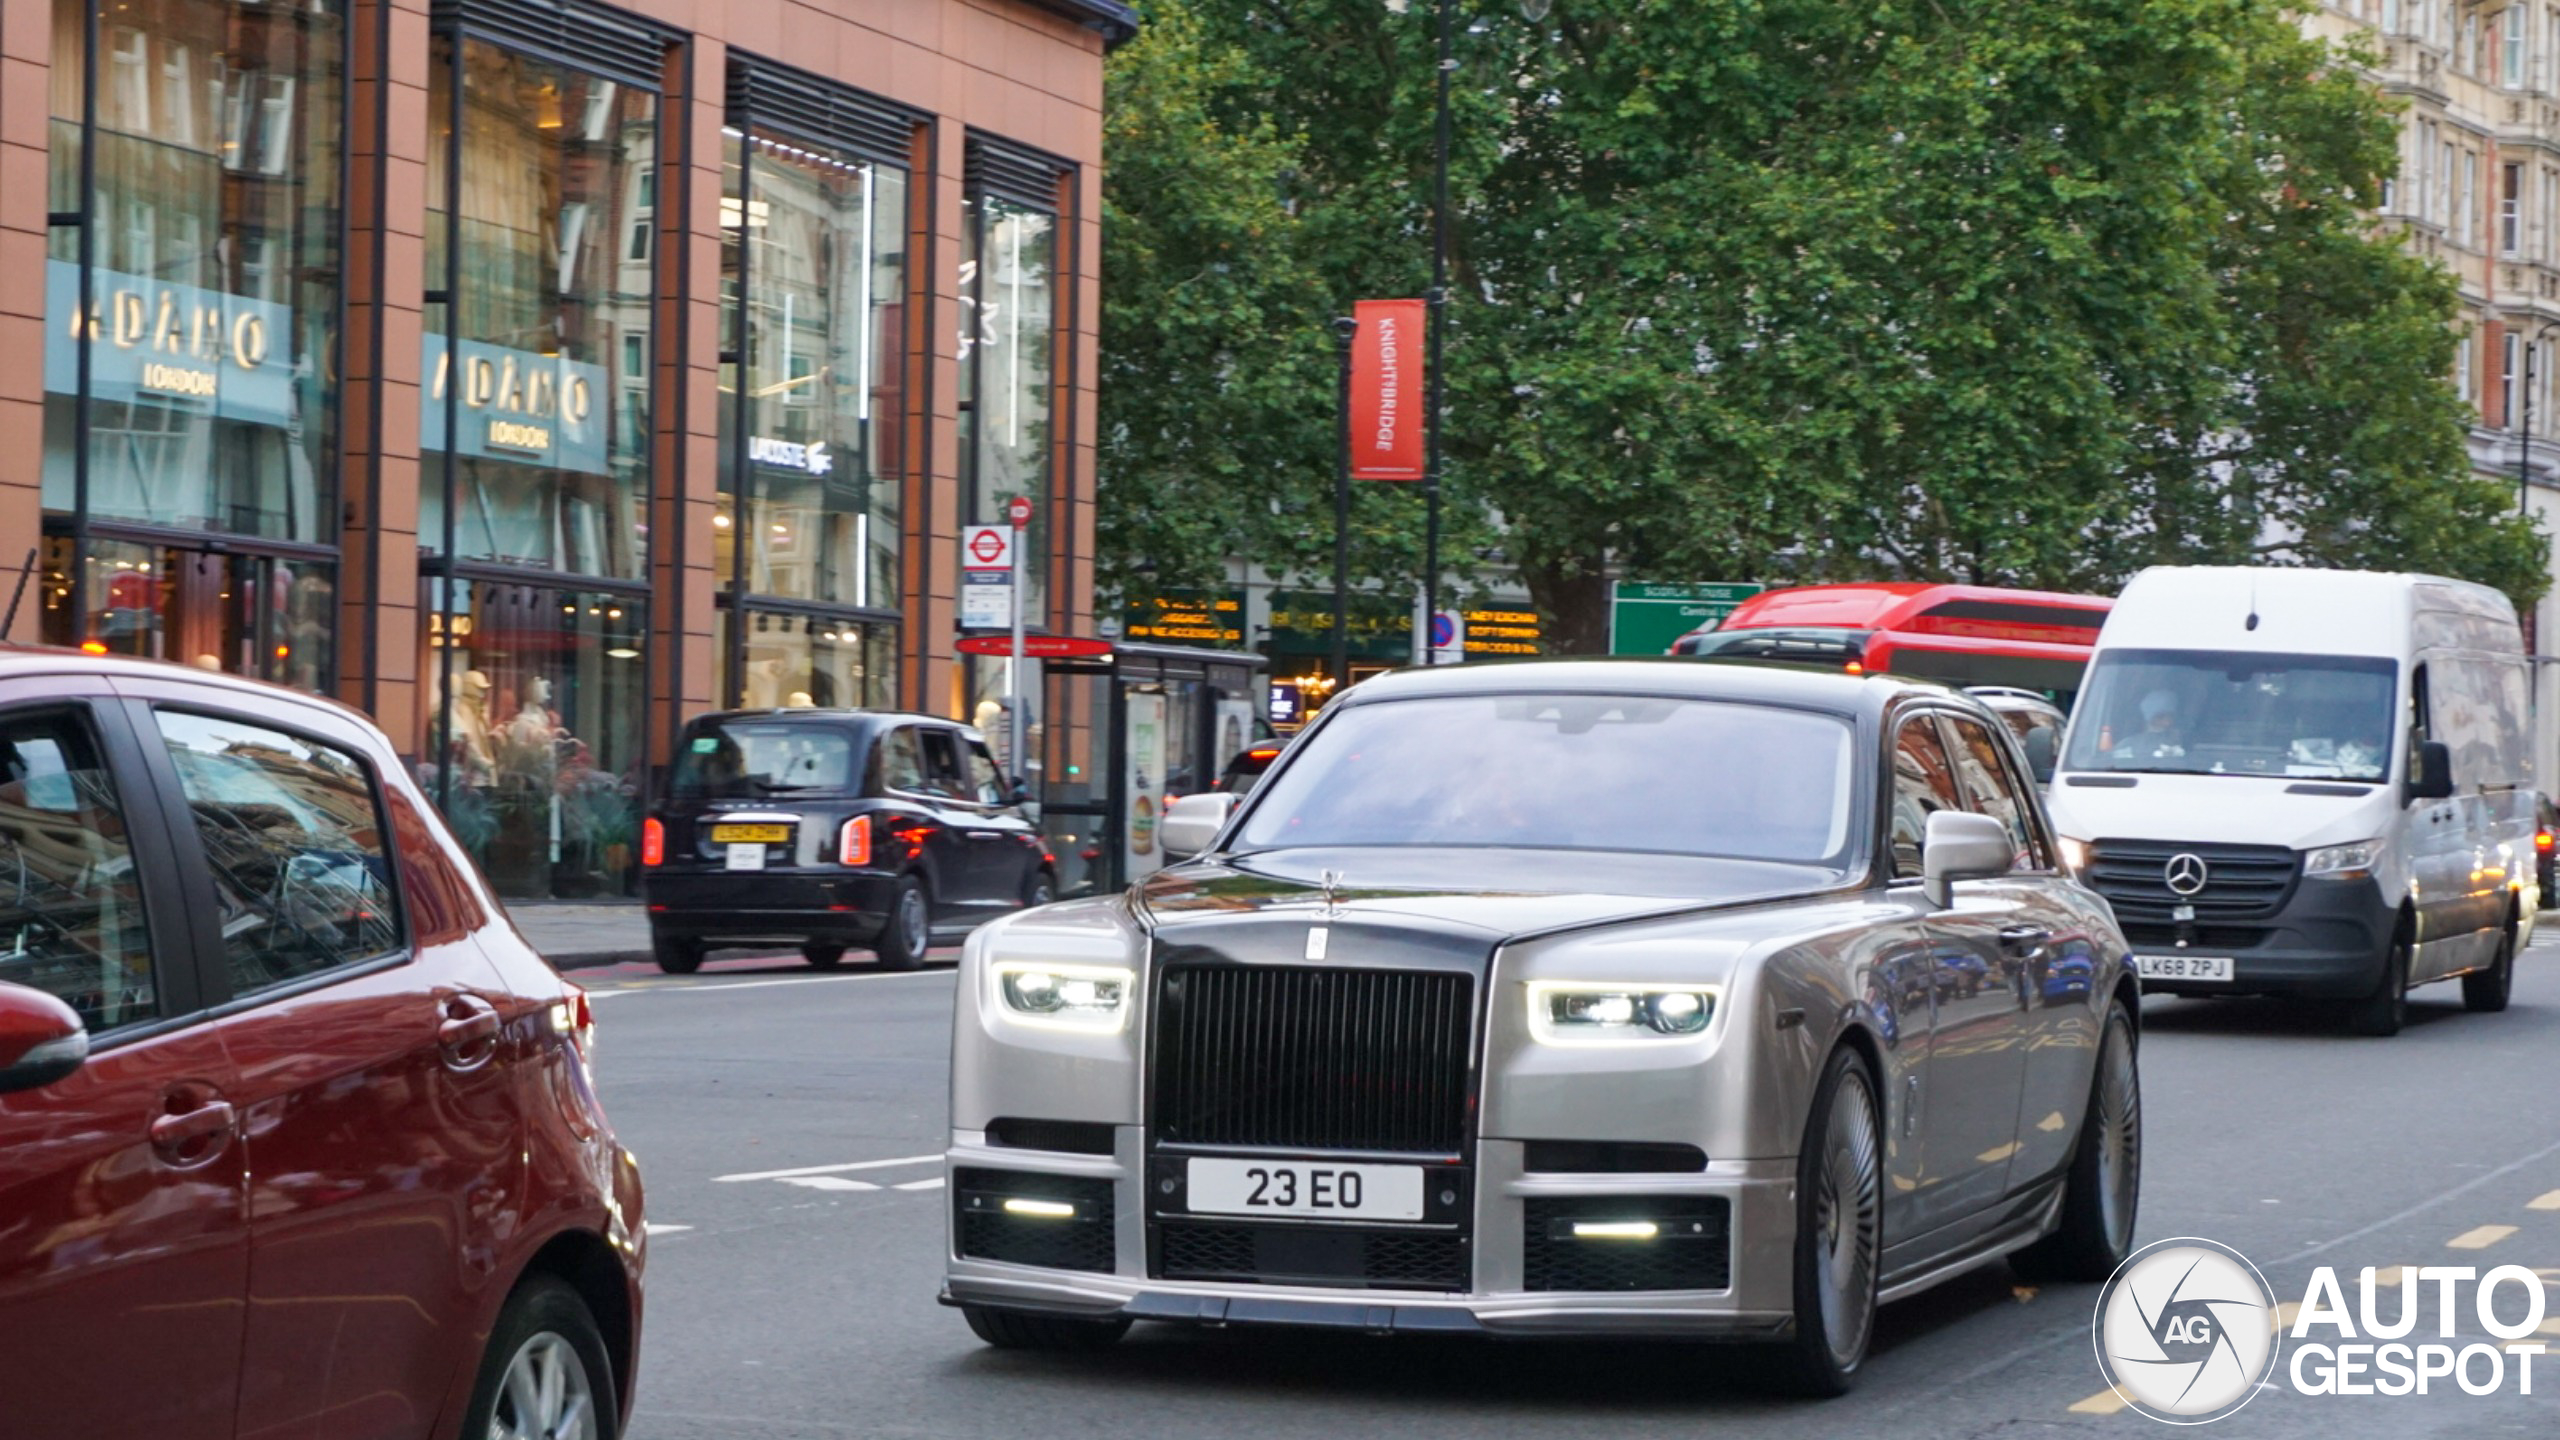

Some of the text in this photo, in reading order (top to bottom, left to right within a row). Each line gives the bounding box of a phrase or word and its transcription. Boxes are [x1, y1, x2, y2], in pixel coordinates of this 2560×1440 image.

[1376, 318, 1398, 452] KNIGHTSBRIDGE
[2141, 958, 2225, 977] LK68 ZPJ
[1246, 1167, 1297, 1207] 23
